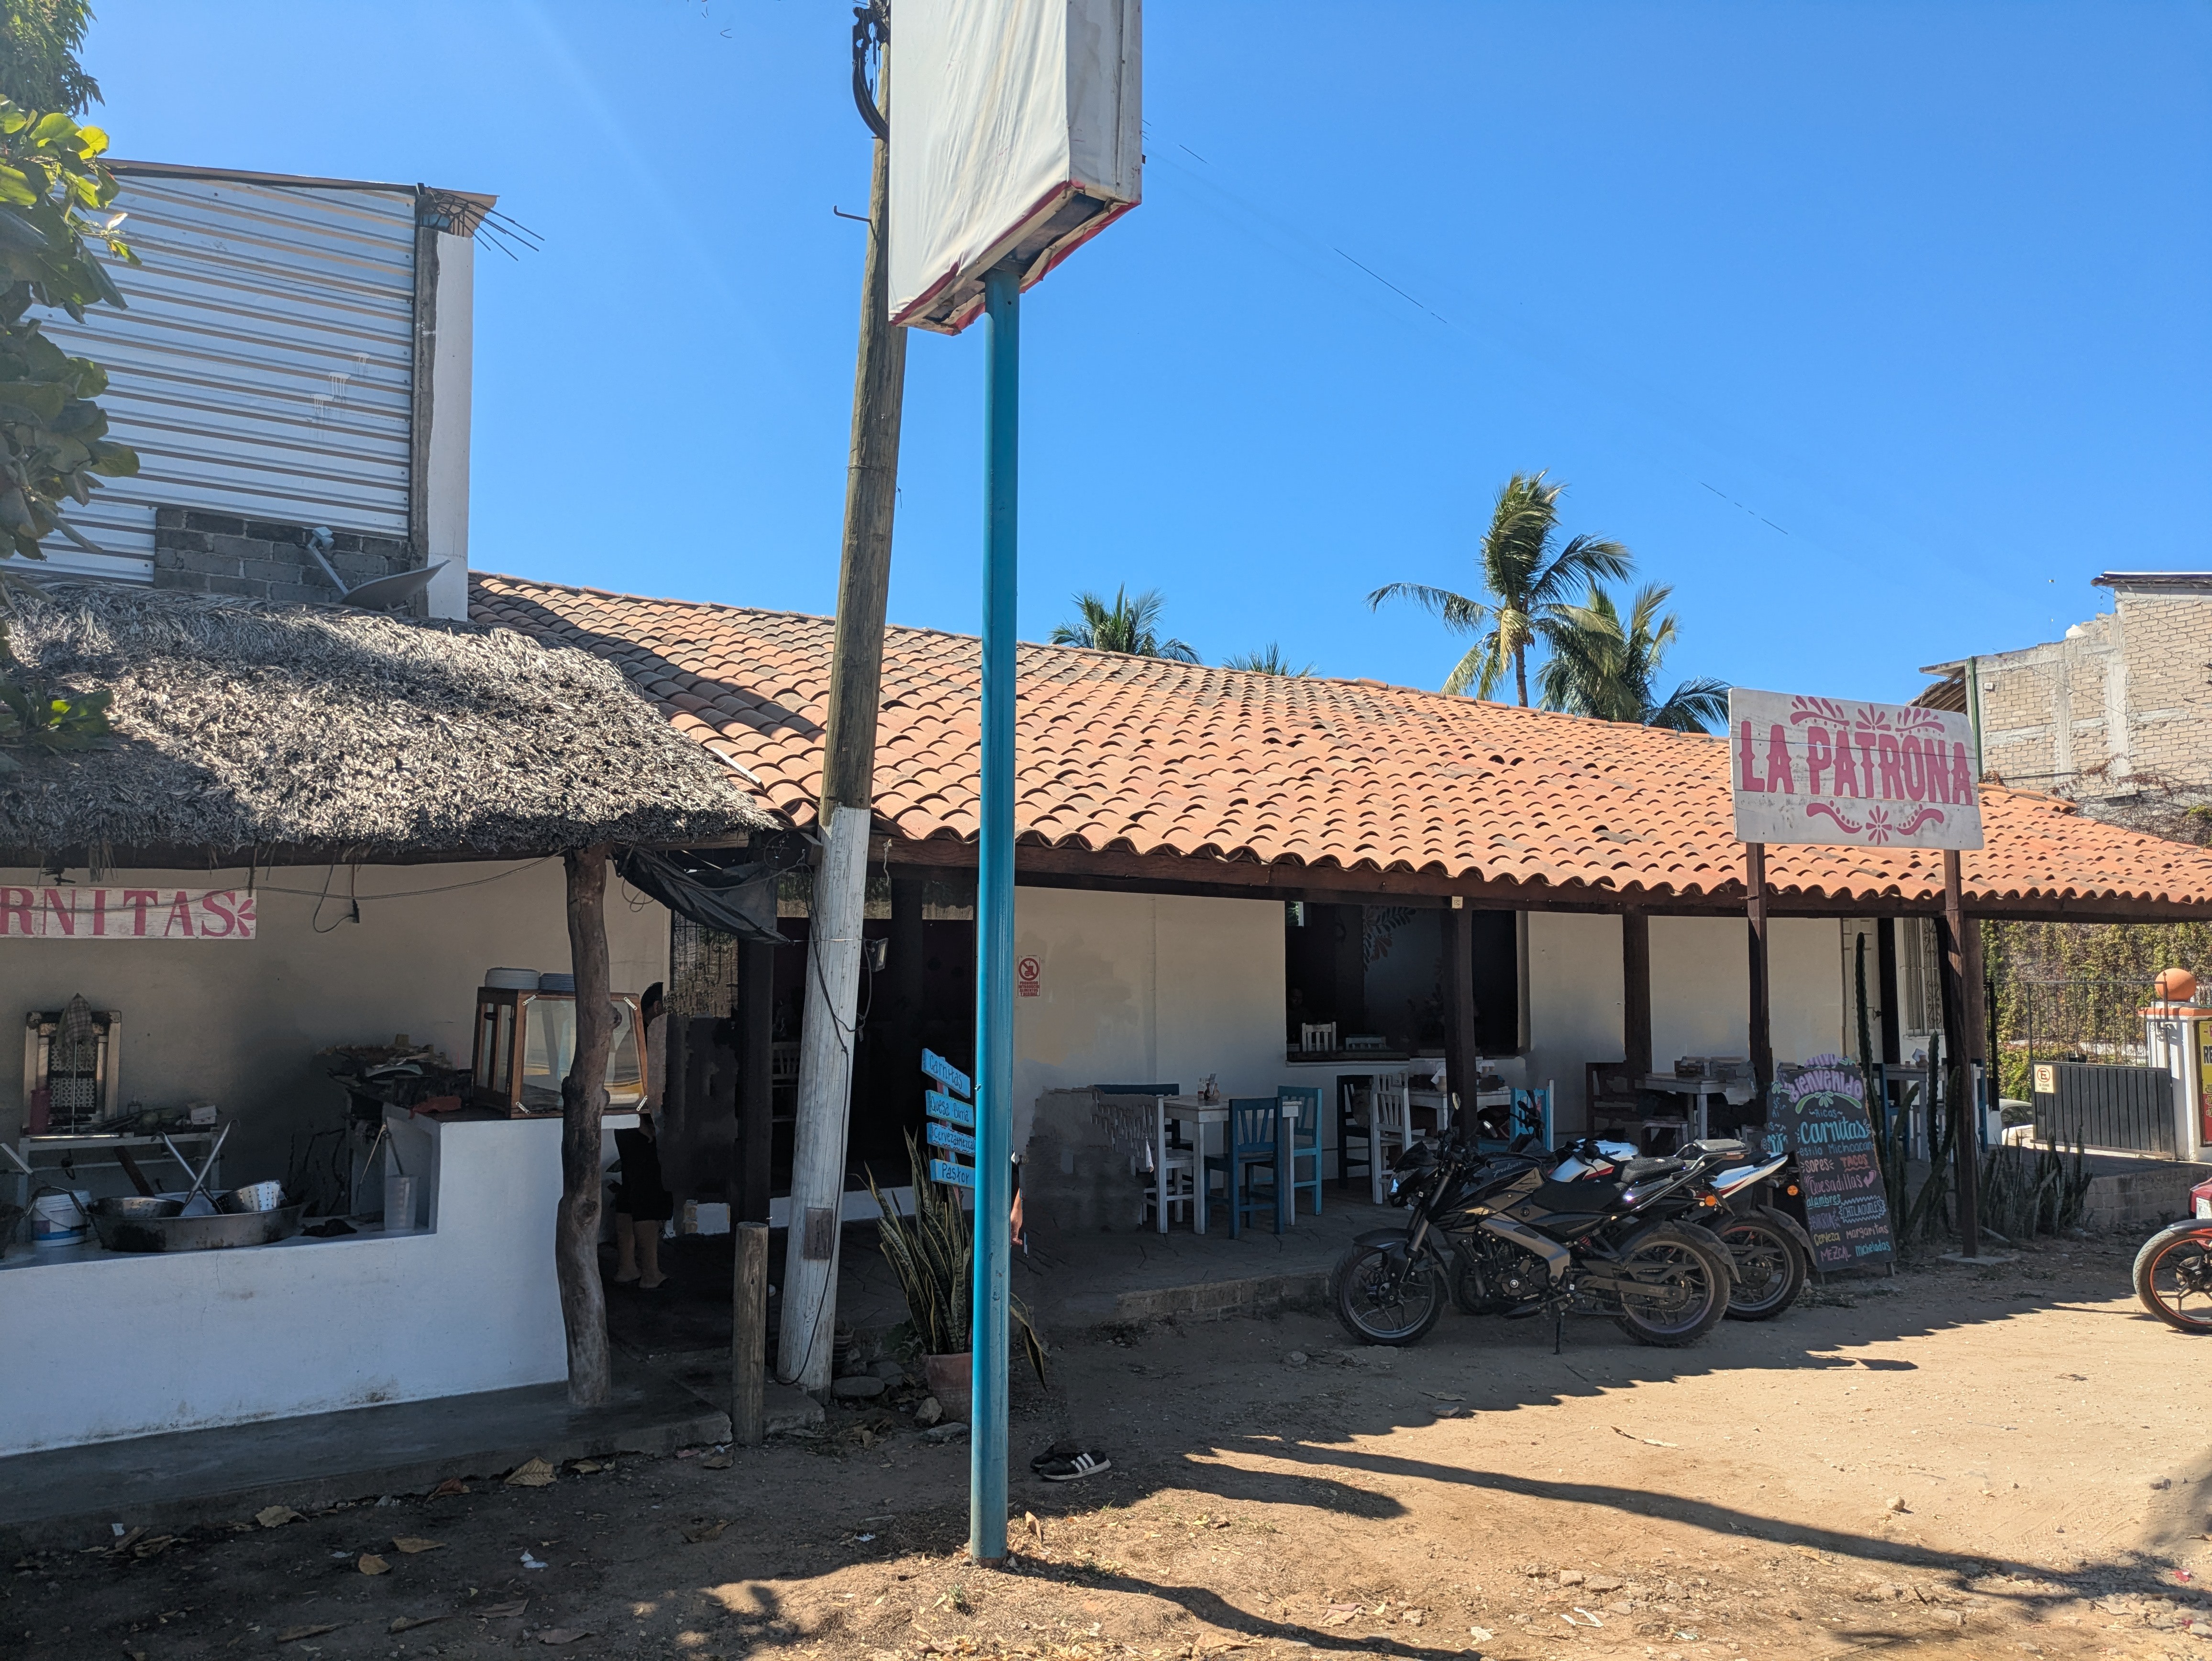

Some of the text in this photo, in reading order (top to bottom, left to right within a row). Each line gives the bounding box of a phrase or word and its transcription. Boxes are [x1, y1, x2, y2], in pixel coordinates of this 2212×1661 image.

[1740, 720, 1973, 805] LA PATRONA
[929, 1055, 962, 1090] Carnitas
[1789, 1070, 1864, 1103] Bienvenido
[931, 1096, 969, 1122] Quesa Birria
[1839, 1154, 1869, 1168] TACOS
[942, 1163, 969, 1185] Pastor
[1809, 1174, 1863, 1195] Quesadillas
[1806, 1194, 1841, 1207] alambres
[1843, 1200, 1884, 1218] CHILAQUILES
[1814, 1232, 1840, 1246] Cerveza
[1820, 1245, 1852, 1262] MEZCAL
